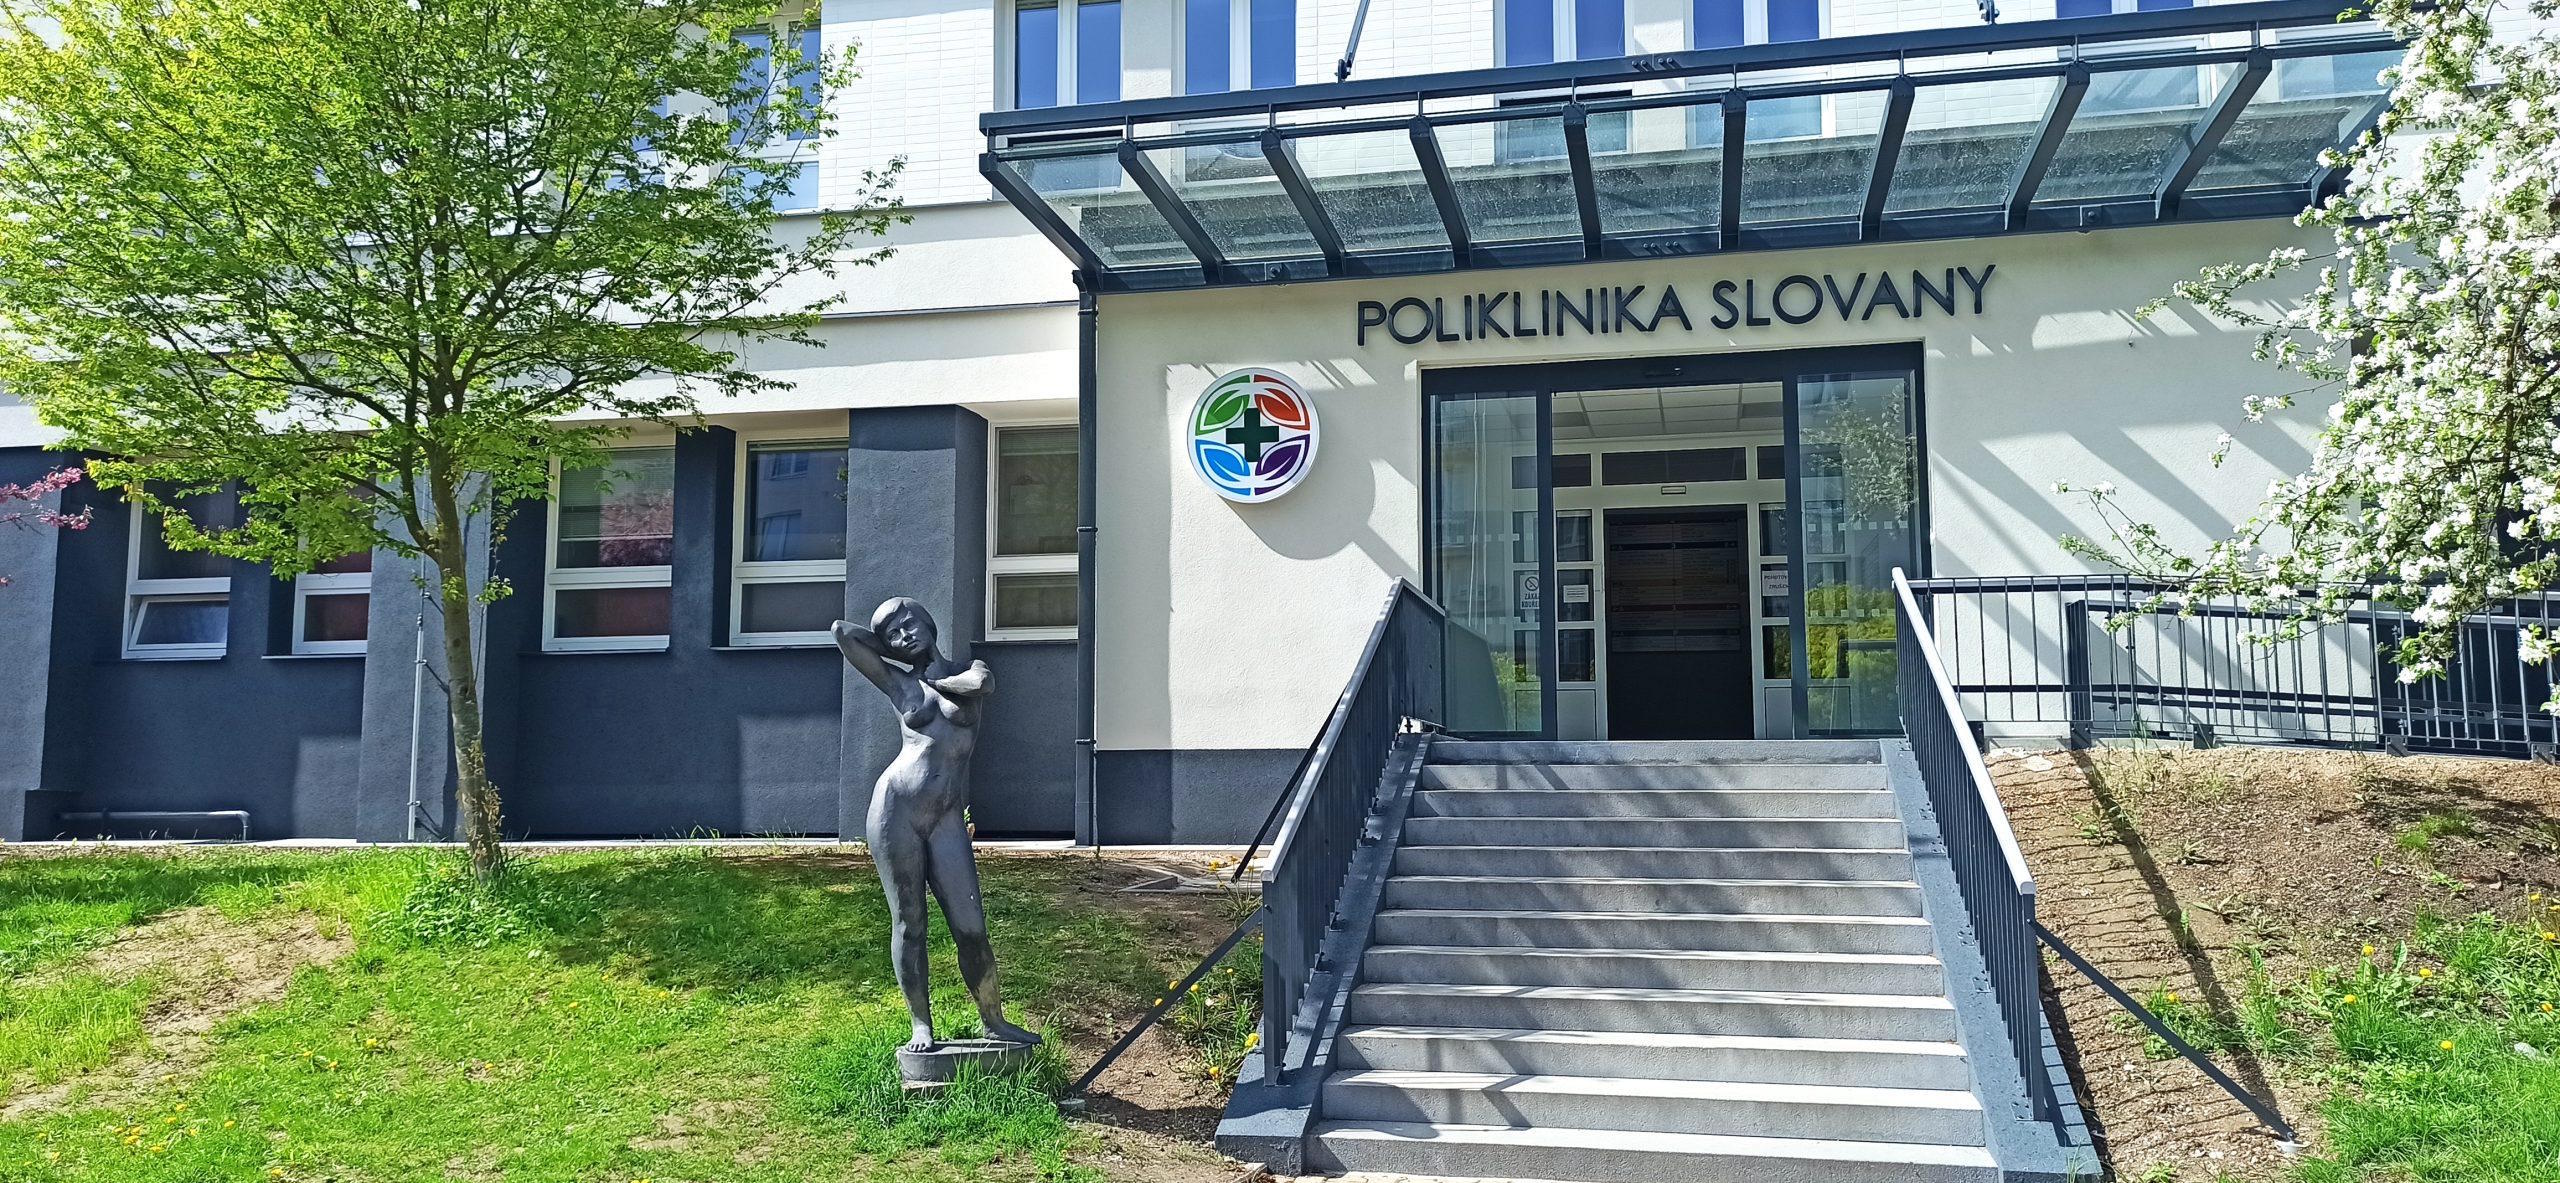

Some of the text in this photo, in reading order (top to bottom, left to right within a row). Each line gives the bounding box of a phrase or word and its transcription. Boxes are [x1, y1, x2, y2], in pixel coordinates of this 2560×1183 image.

[1357, 264, 1996, 346] POLIKLINIKA SLOVANY
[1524, 592, 1539, 600] ZÁKA
[1521, 600, 1539, 608] KOUŘE
